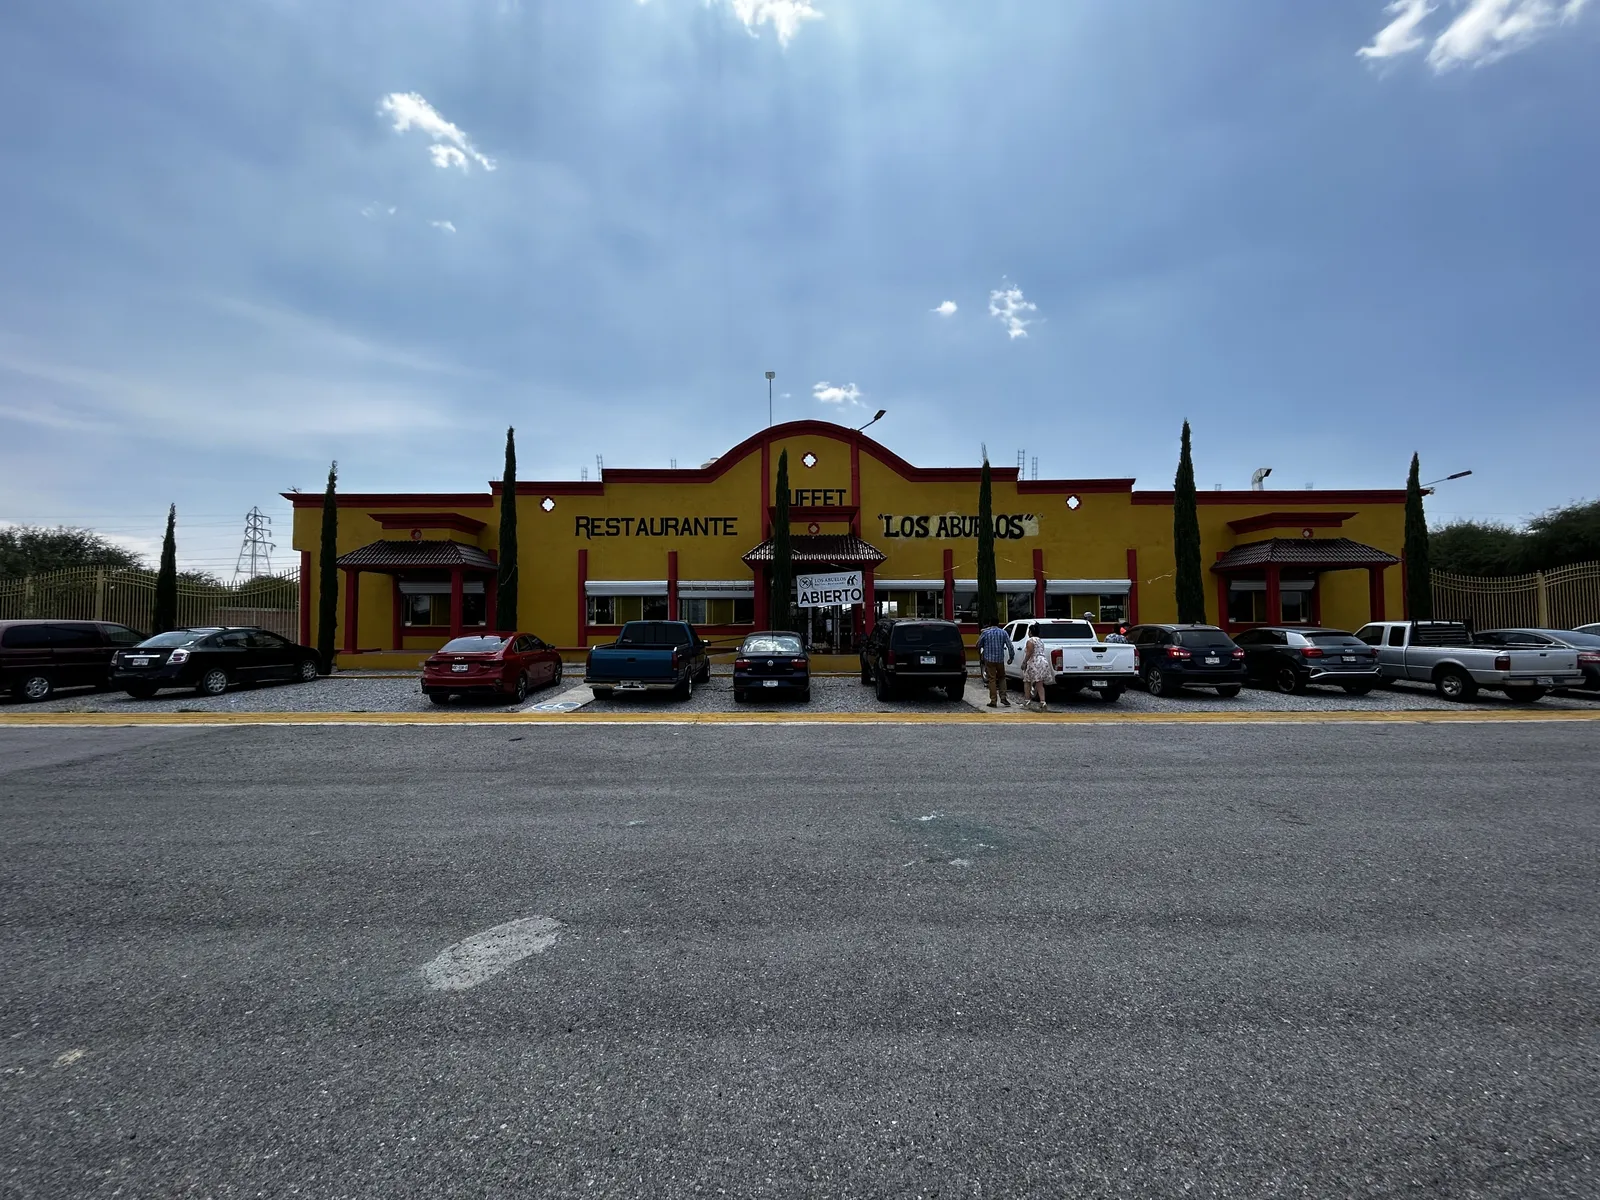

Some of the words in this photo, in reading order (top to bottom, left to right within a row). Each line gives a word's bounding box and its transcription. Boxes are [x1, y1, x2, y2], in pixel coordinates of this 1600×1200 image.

[786, 488, 847, 507] UFFET
[575, 516, 738, 540] RESTAURANTE
[800, 588, 862, 604] ABIERTO
